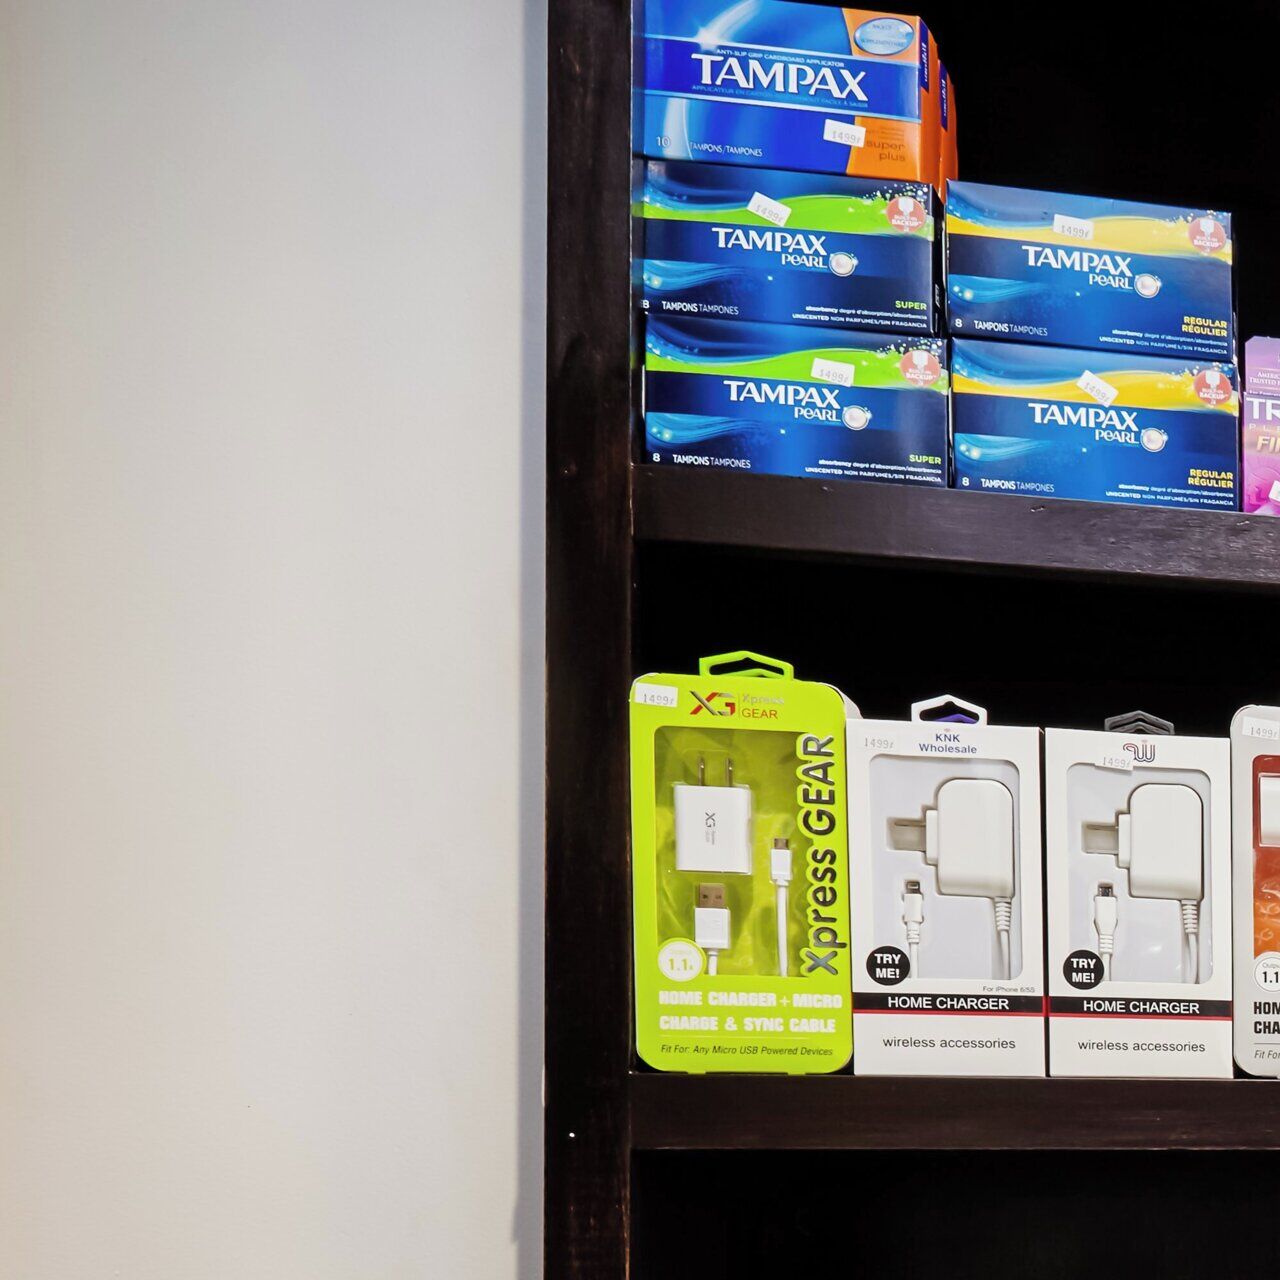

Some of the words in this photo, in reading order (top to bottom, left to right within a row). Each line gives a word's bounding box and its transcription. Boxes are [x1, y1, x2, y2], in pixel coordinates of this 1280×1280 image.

[692, 53, 868, 102] TAMPAX
[879, 151, 906, 162] plus
[712, 228, 827, 256] TAMPAX
[1022, 245, 1134, 276] TAMPAX
[895, 300, 927, 310] SUPER
[1183, 316, 1228, 328] REGULAR
[908, 454, 942, 465] SUPER
[689, 691, 736, 716] XG
[935, 733, 960, 743] KNK
[919, 743, 977, 754] Wholesale
[875, 953, 901, 964] TRY
[1071, 958, 1096, 969] TRY
[876, 968, 899, 979] ME!
[1072, 972, 1095, 983] ME!
[888, 996, 932, 1008] HOME
[936, 997, 1009, 1010] CHARGER
[1083, 1000, 1125, 1012] HOME
[1129, 1001, 1199, 1014] CHARGER
[883, 1037, 935, 1049] wireless
[939, 1037, 1016, 1049] accessories
[1078, 1040, 1129, 1052] wireless
[1132, 1041, 1206, 1053] accessories
[661, 1044, 672, 1054] Fit
[693, 1045, 709, 1056] Any
[712, 1045, 737, 1056] Micro
[740, 1046, 758, 1056] USB
[761, 1047, 799, 1057] Powered
[801, 1048, 833, 1057] Devices
